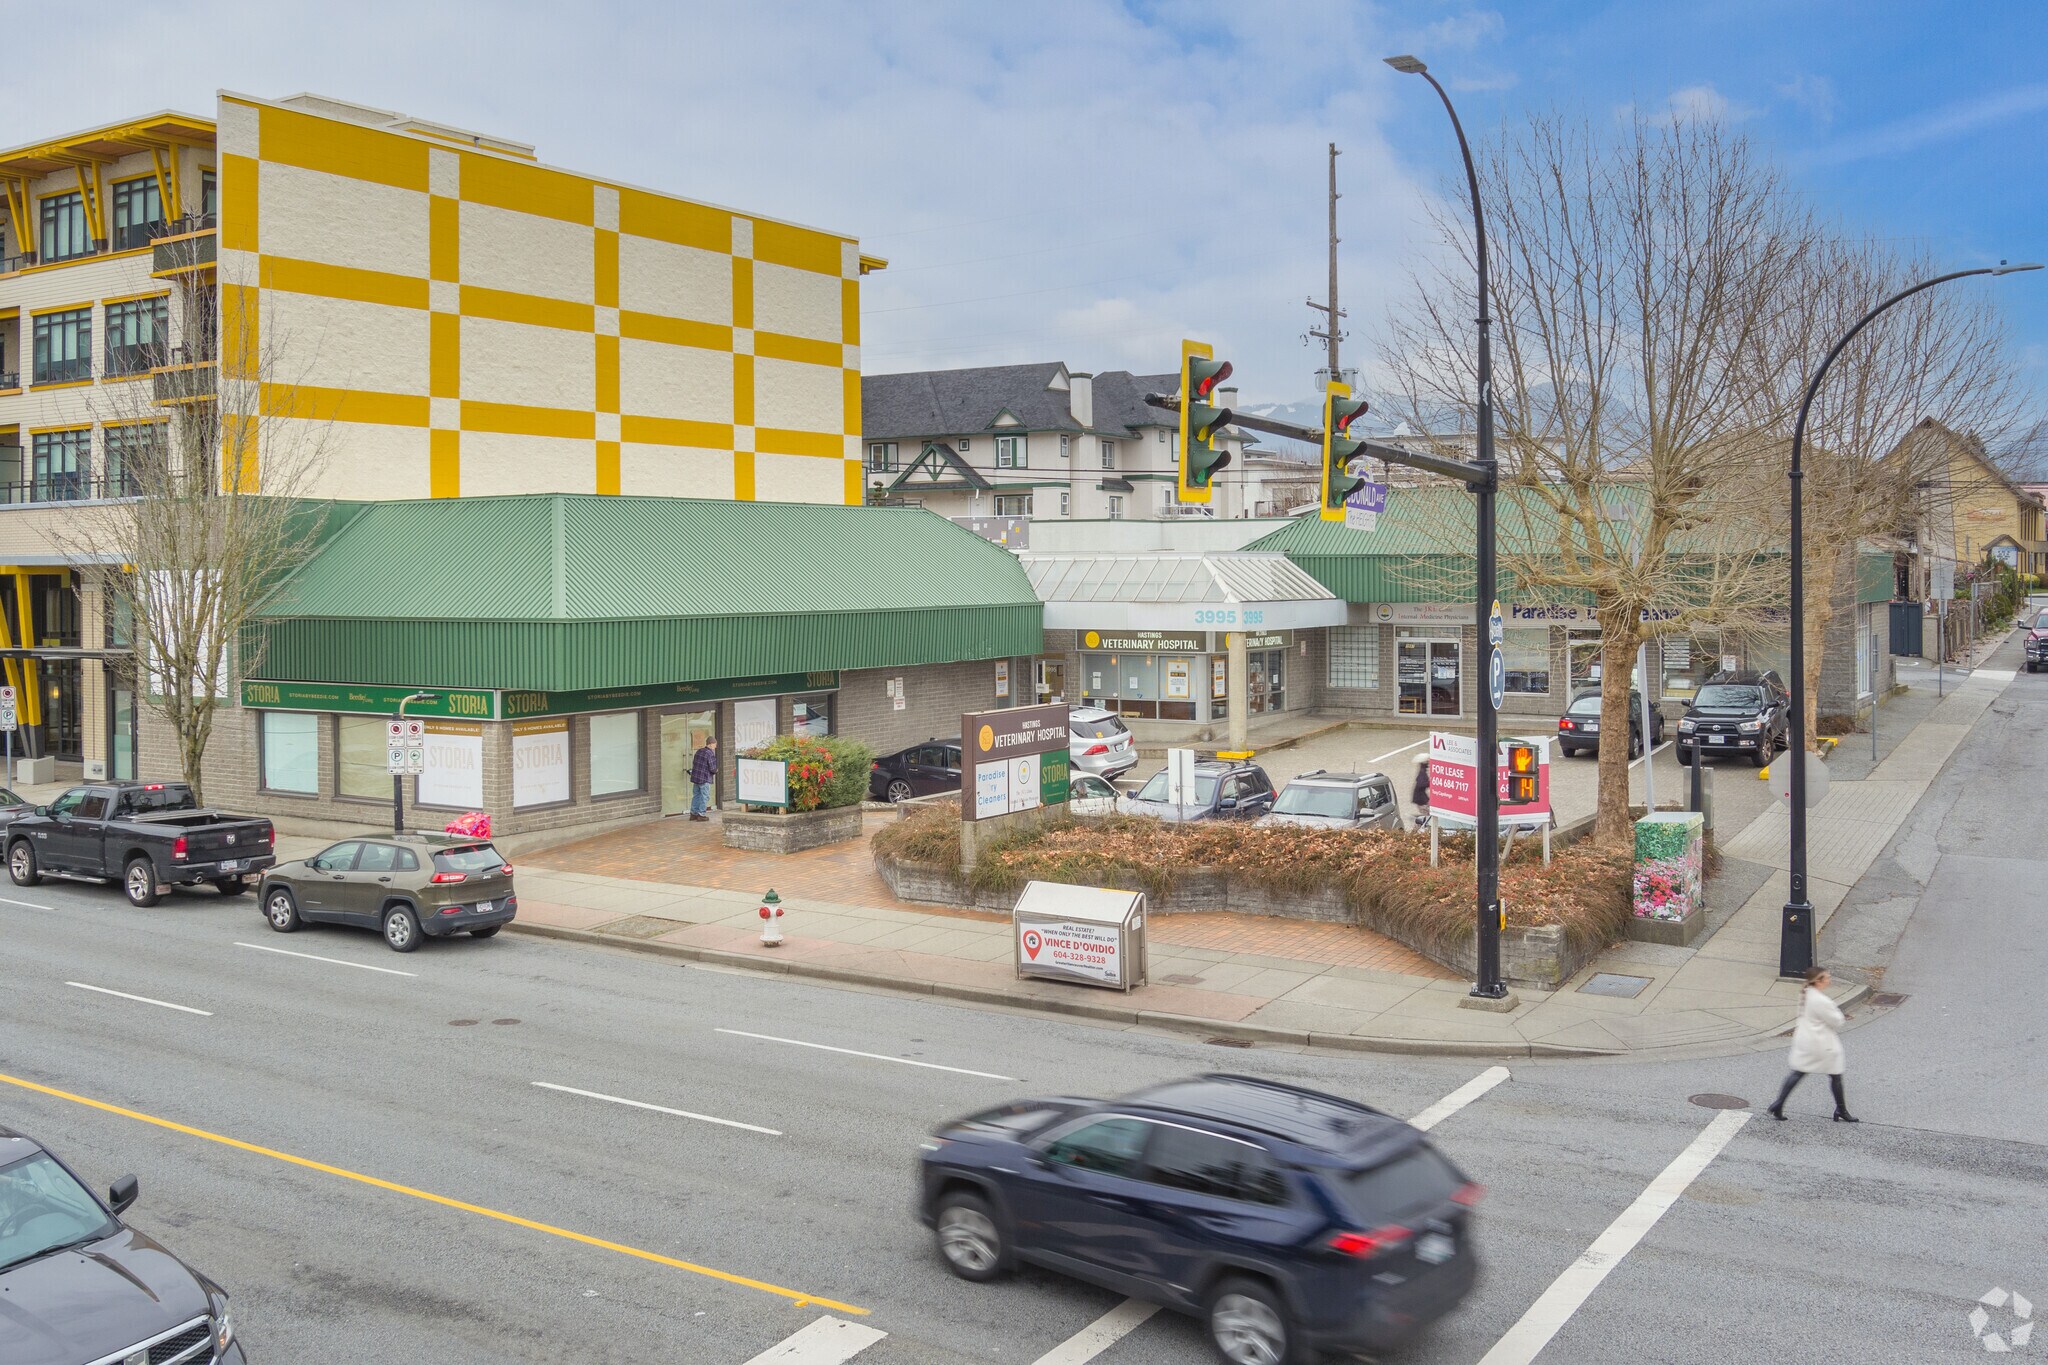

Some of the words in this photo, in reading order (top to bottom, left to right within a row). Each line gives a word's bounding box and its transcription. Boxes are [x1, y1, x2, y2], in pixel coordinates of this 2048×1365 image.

[1194, 610, 1237, 624] 3995
[1243, 610, 1263, 624] 3995
[1513, 604, 1577, 619] Paradise
[1102, 639, 1155, 649] VETERINARY
[1157, 639, 1199, 650] HOSPITAL
[1264, 635, 1283, 646] HOSPITAL
[1022, 720, 1041, 729] HASTINGS
[994, 731, 1036, 748] VETERINARY
[1037, 726, 1067, 742] HOSPITAL
[1448, 746, 1472, 755] ASSOCIATES
[978, 769, 1006, 782] Paradise
[1431, 764, 1445, 775] FOR
[1445, 767, 1464, 779] LEASE
[1431, 776, 1443, 787] 604
[1443, 779, 1455, 790] 684
[1455, 783, 1469, 792] 7117
[1521, 778, 1533, 798] 14
[978, 793, 1007, 806] Cleaners
[1044, 937, 1071, 949] VINCE
[1073, 941, 1115, 955] D'OVIDIO
[1053, 950, 1106, 964] 604-328-9328
